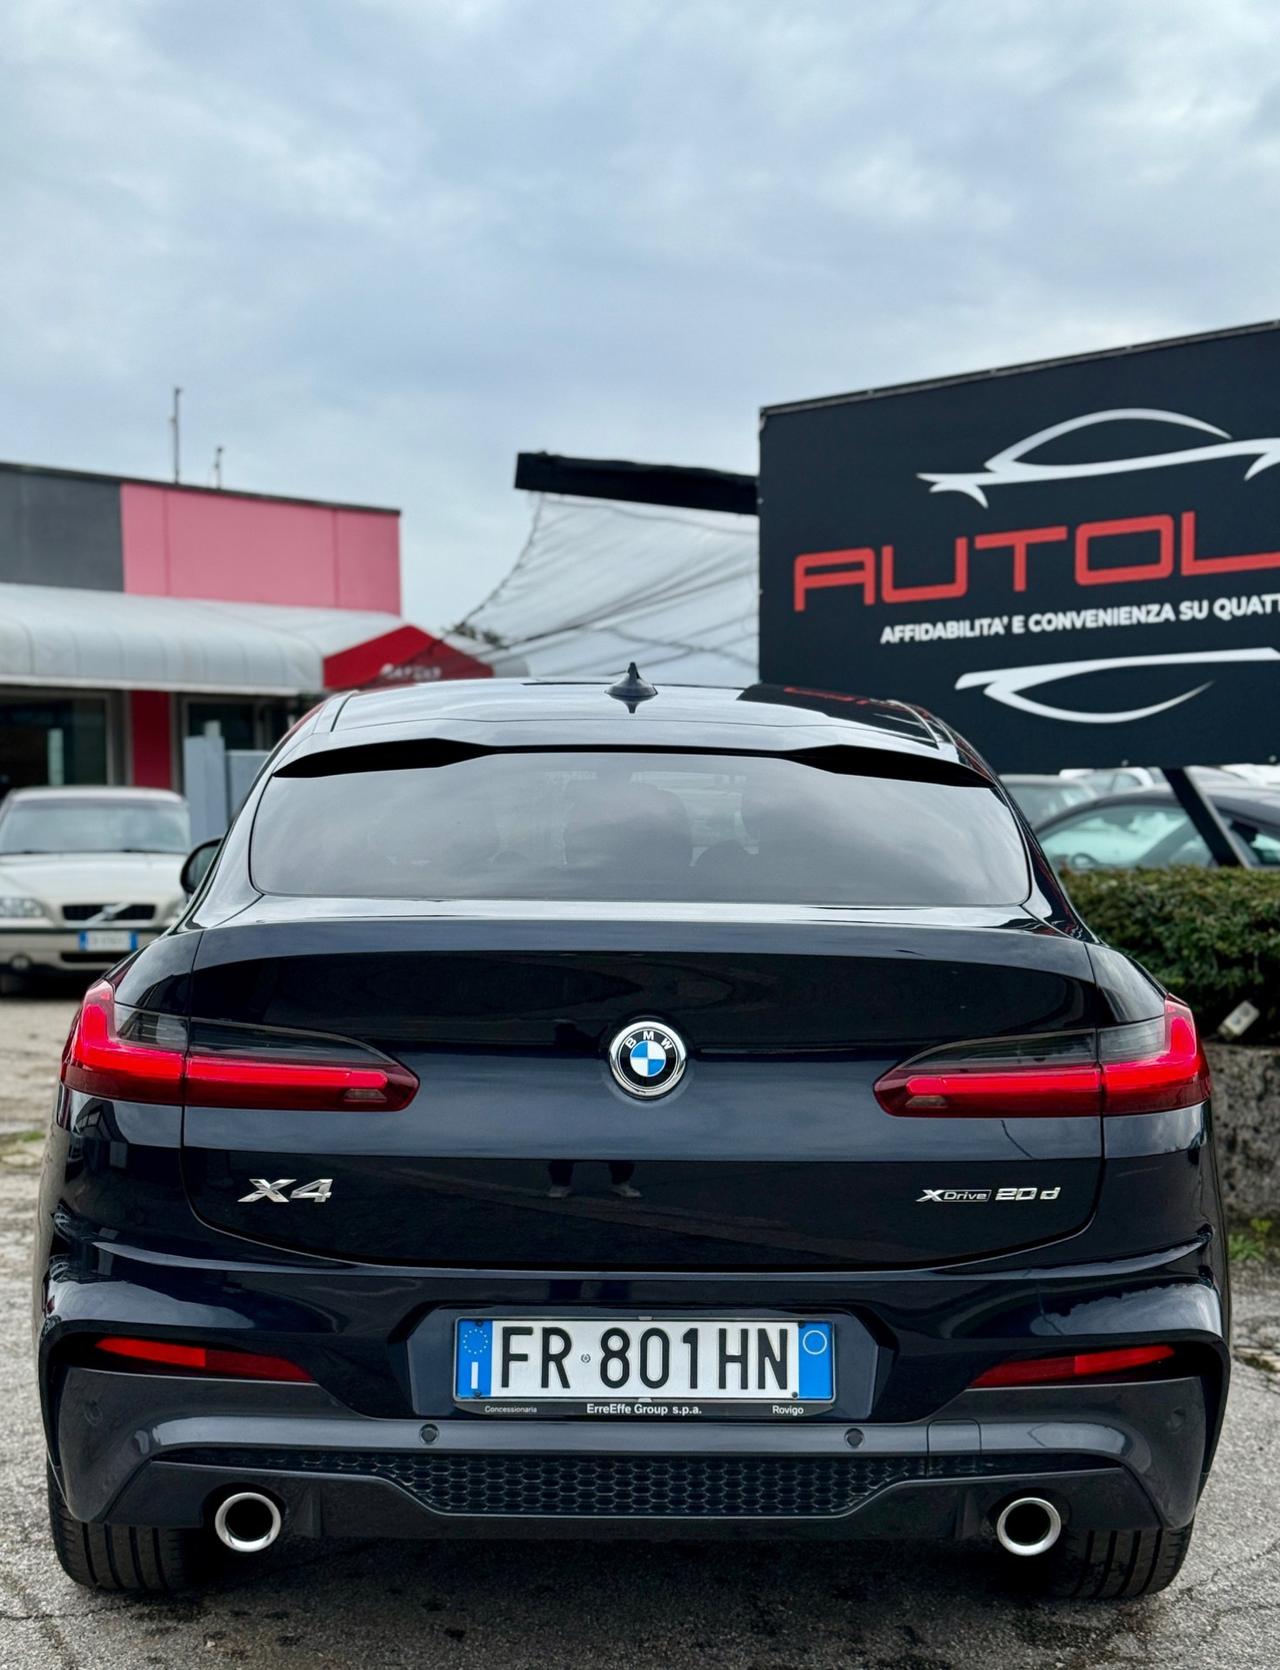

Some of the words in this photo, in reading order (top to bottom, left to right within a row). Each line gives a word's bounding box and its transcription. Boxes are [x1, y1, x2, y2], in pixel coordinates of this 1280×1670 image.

[794, 511, 1280, 612] AUTOL
[880, 616, 1009, 644] AFFIDABILITA'
[1011, 615, 1026, 634] E
[1028, 602, 1176, 633] CONVENIENZA
[1179, 600, 1209, 621] SU
[624, 1031, 673, 1050] BMW
[237, 1179, 333, 1202] X4
[501, 1326, 572, 1389] FR
[484, 1405, 538, 1413] Concessionaria
[586, 1403, 632, 1414] ErreEffe
[634, 1404, 669, 1416] Group
[672, 1405, 703, 1415] s.p.a.
[772, 1405, 804, 1416] Rovigo
